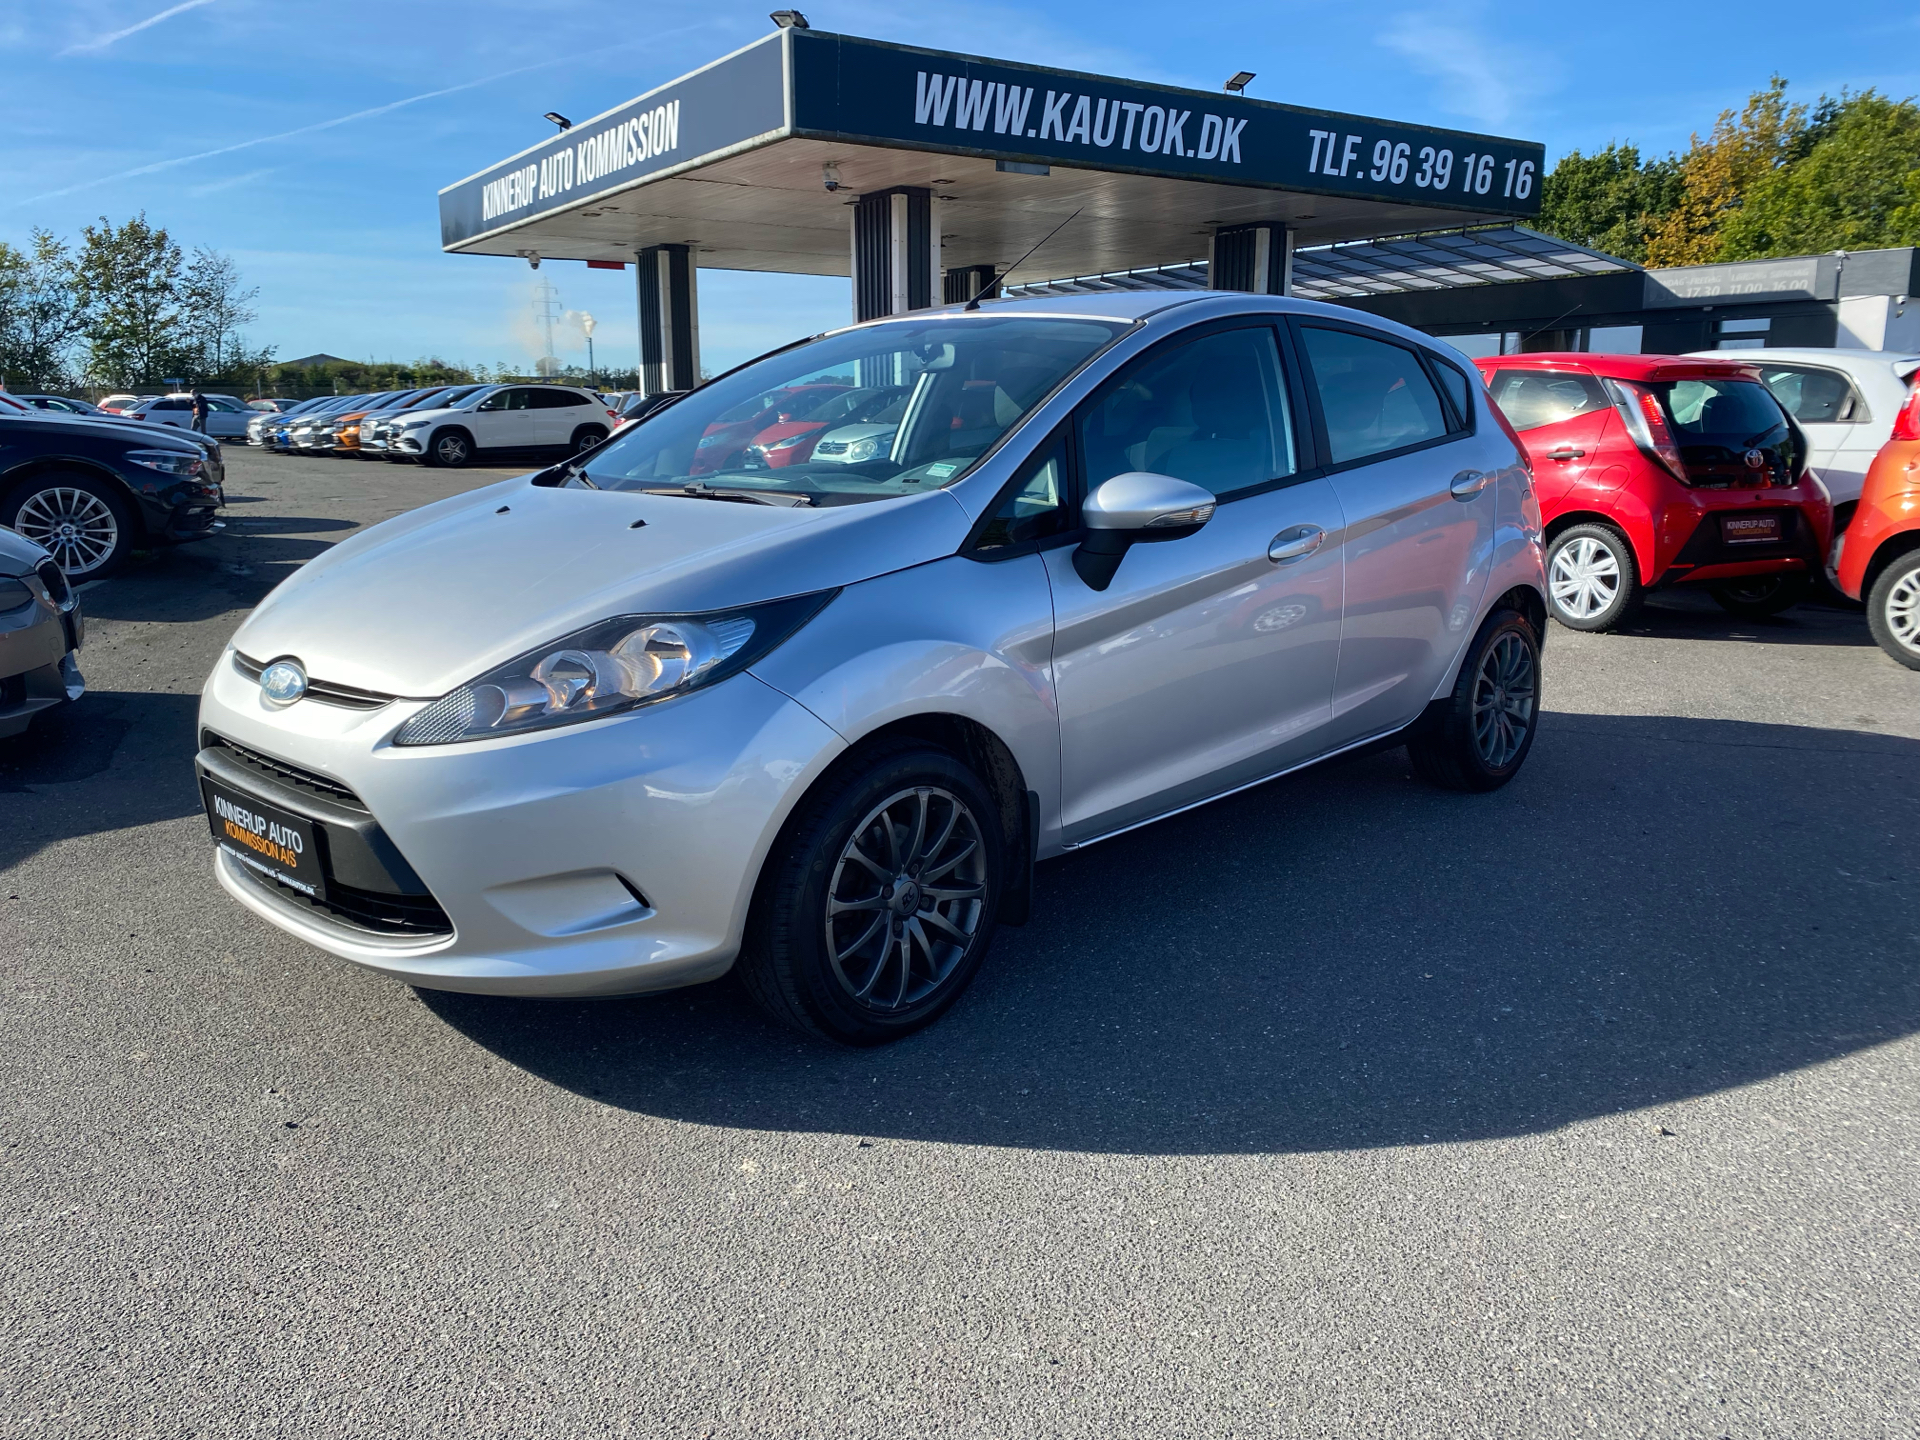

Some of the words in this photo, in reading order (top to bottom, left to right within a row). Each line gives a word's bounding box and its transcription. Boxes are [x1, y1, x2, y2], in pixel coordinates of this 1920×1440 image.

[914, 71, 1248, 164] WWW.KAUTOK.DK
[482, 164, 537, 222] KINNERUP
[539, 147, 574, 200] AUTO
[576, 99, 680, 186] KOMMISSION
[1308, 129, 1364, 179] TLF.
[1370, 139, 1411, 184] 96
[1415, 146, 1454, 190] 39
[1463, 152, 1495, 194] 16
[1503, 158, 1535, 200] 16
[1727, 520, 1758, 530] KINNERUP
[1759, 519, 1776, 528] AUTO
[214, 795, 267, 836] KINNERUP
[269, 822, 303, 854] AUTO
[225, 819, 279, 860] KOMMISSION
